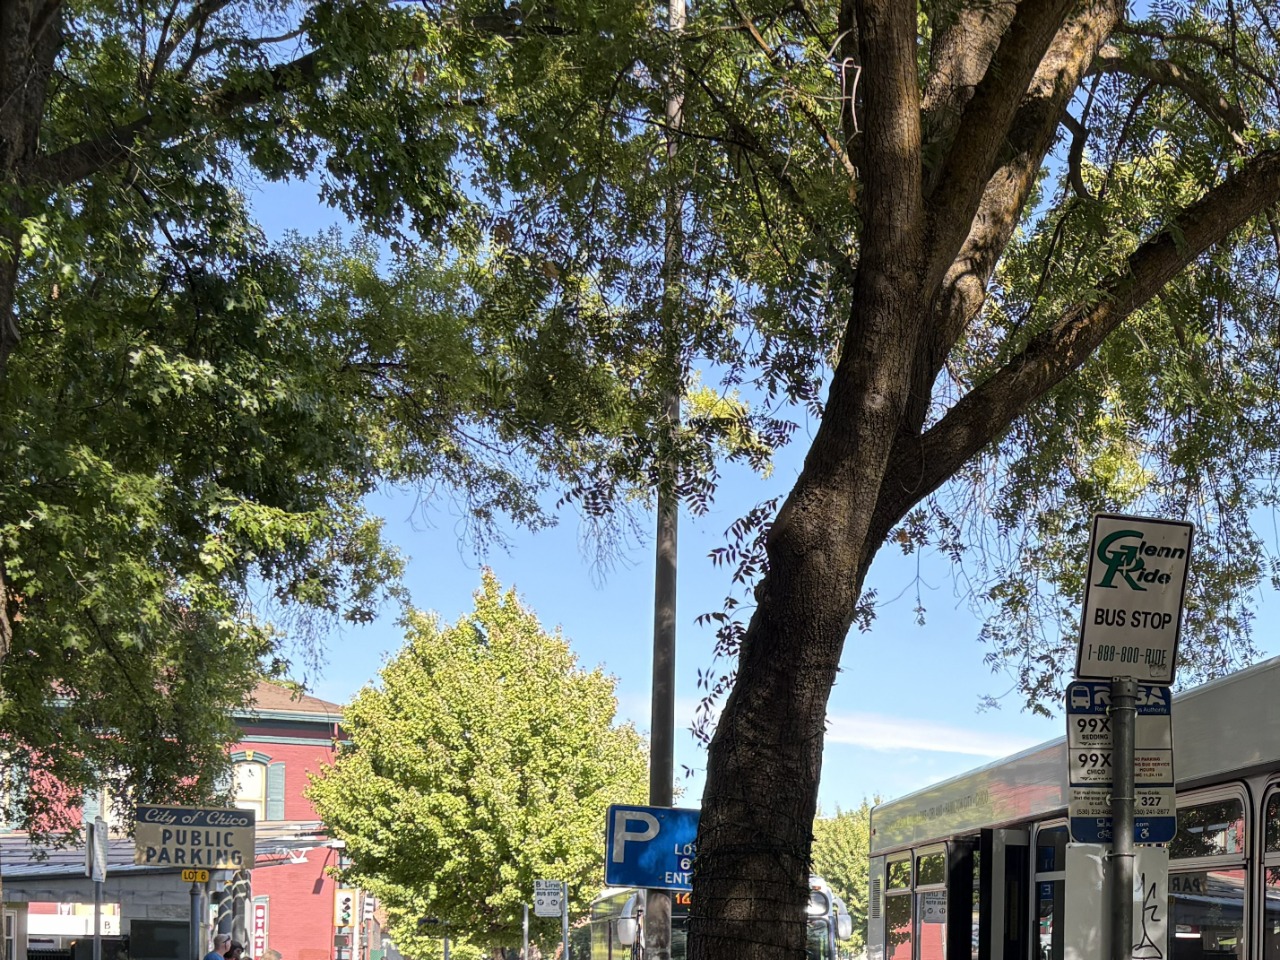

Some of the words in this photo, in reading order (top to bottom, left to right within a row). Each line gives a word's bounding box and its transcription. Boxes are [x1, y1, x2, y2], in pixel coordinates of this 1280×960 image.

[1097, 530, 1186, 567] Glenn
[1094, 551, 1172, 591] Ride
[1094, 608, 1127, 628] BUS
[1130, 611, 1173, 630] STOP
[1088, 644, 1168, 665] 1-888-800-RIDE
[1094, 685, 1166, 706] RBA
[1077, 718, 1111, 733] 99X
[1078, 753, 1112, 768] 99X
[1141, 796, 1162, 807] 327
[145, 808, 177, 825] City
[181, 810, 204, 824] of
[206, 810, 248, 826] Chico
[162, 828, 235, 848] PUBLIC
[146, 846, 243, 866] PARKING
[680, 857, 691, 870] 6
[184, 870, 199, 880] LOT
[200, 870, 206, 880] 6
[544, 880, 560, 888] Line
[664, 871, 693, 885] ENT
